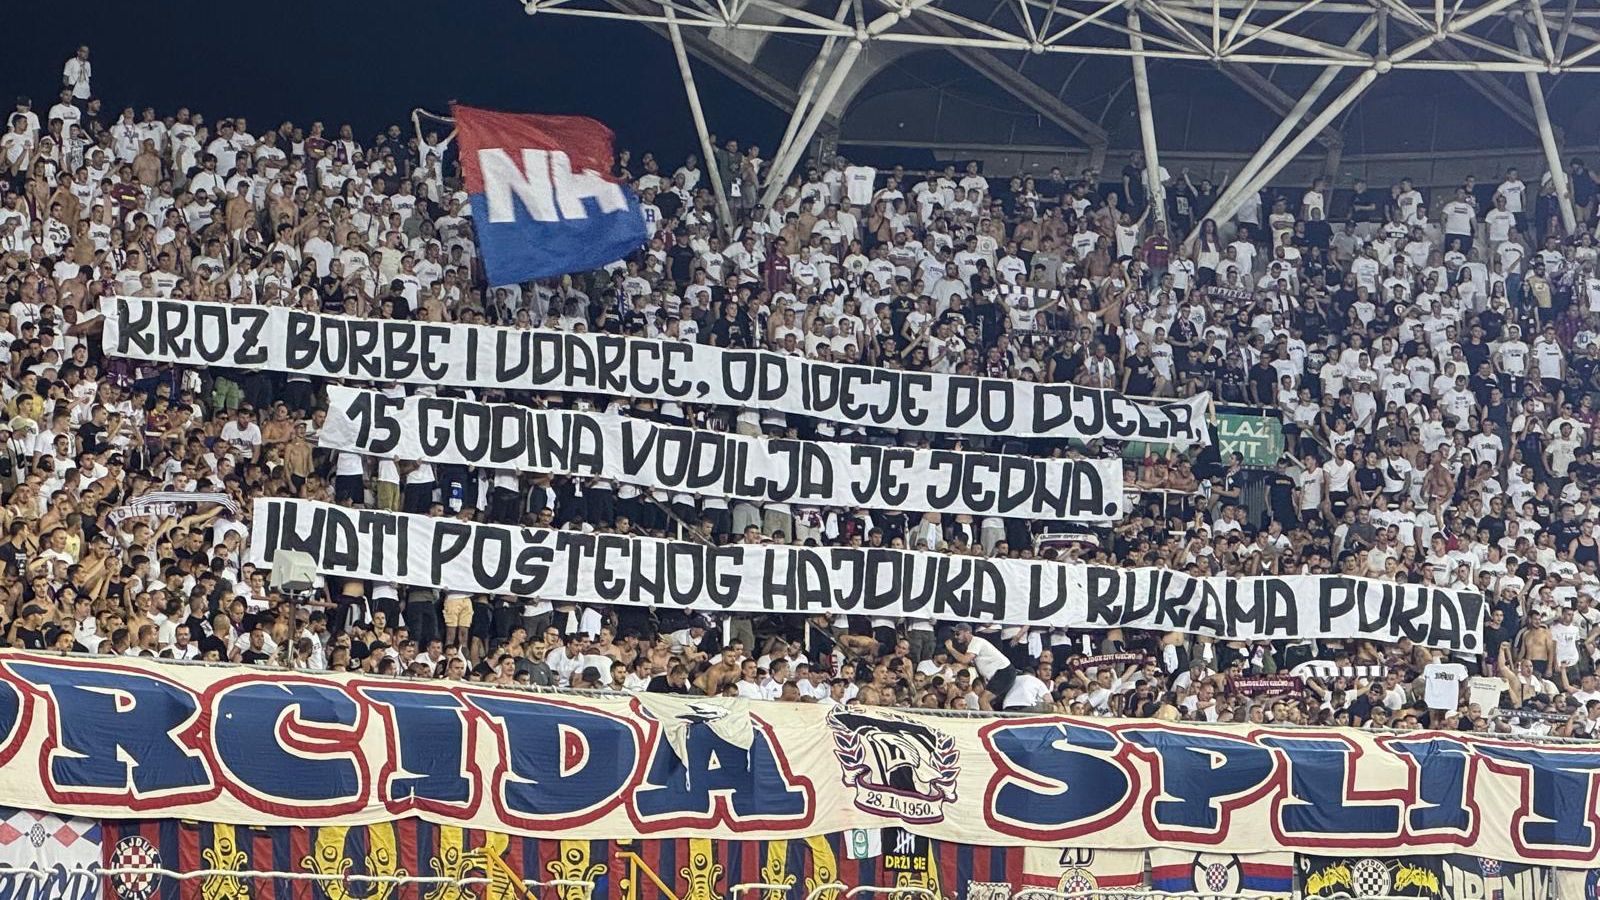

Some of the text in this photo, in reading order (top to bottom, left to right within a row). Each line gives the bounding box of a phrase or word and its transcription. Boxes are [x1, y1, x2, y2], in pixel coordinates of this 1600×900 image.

[479, 148, 629, 222] NH
[645, 208, 656, 222] H
[116, 298, 1202, 442] KROZ BORBE I UDARCE, OD IDEJE DO DJELA,
[345, 391, 1118, 518] 15 GODINA VODILJA JE JEDNA.
[263, 501, 1483, 651] IMATI POŠTENOG HAJDUKA U RUKAMA PUKA!
[0, 653, 815, 834] RCIDA
[978, 715, 1600, 860] SPLIT
[866, 791, 885, 807] 28.
[885, 855, 926, 870] DRŽI SE
[1356, 860, 1385, 874] HAJDUK
